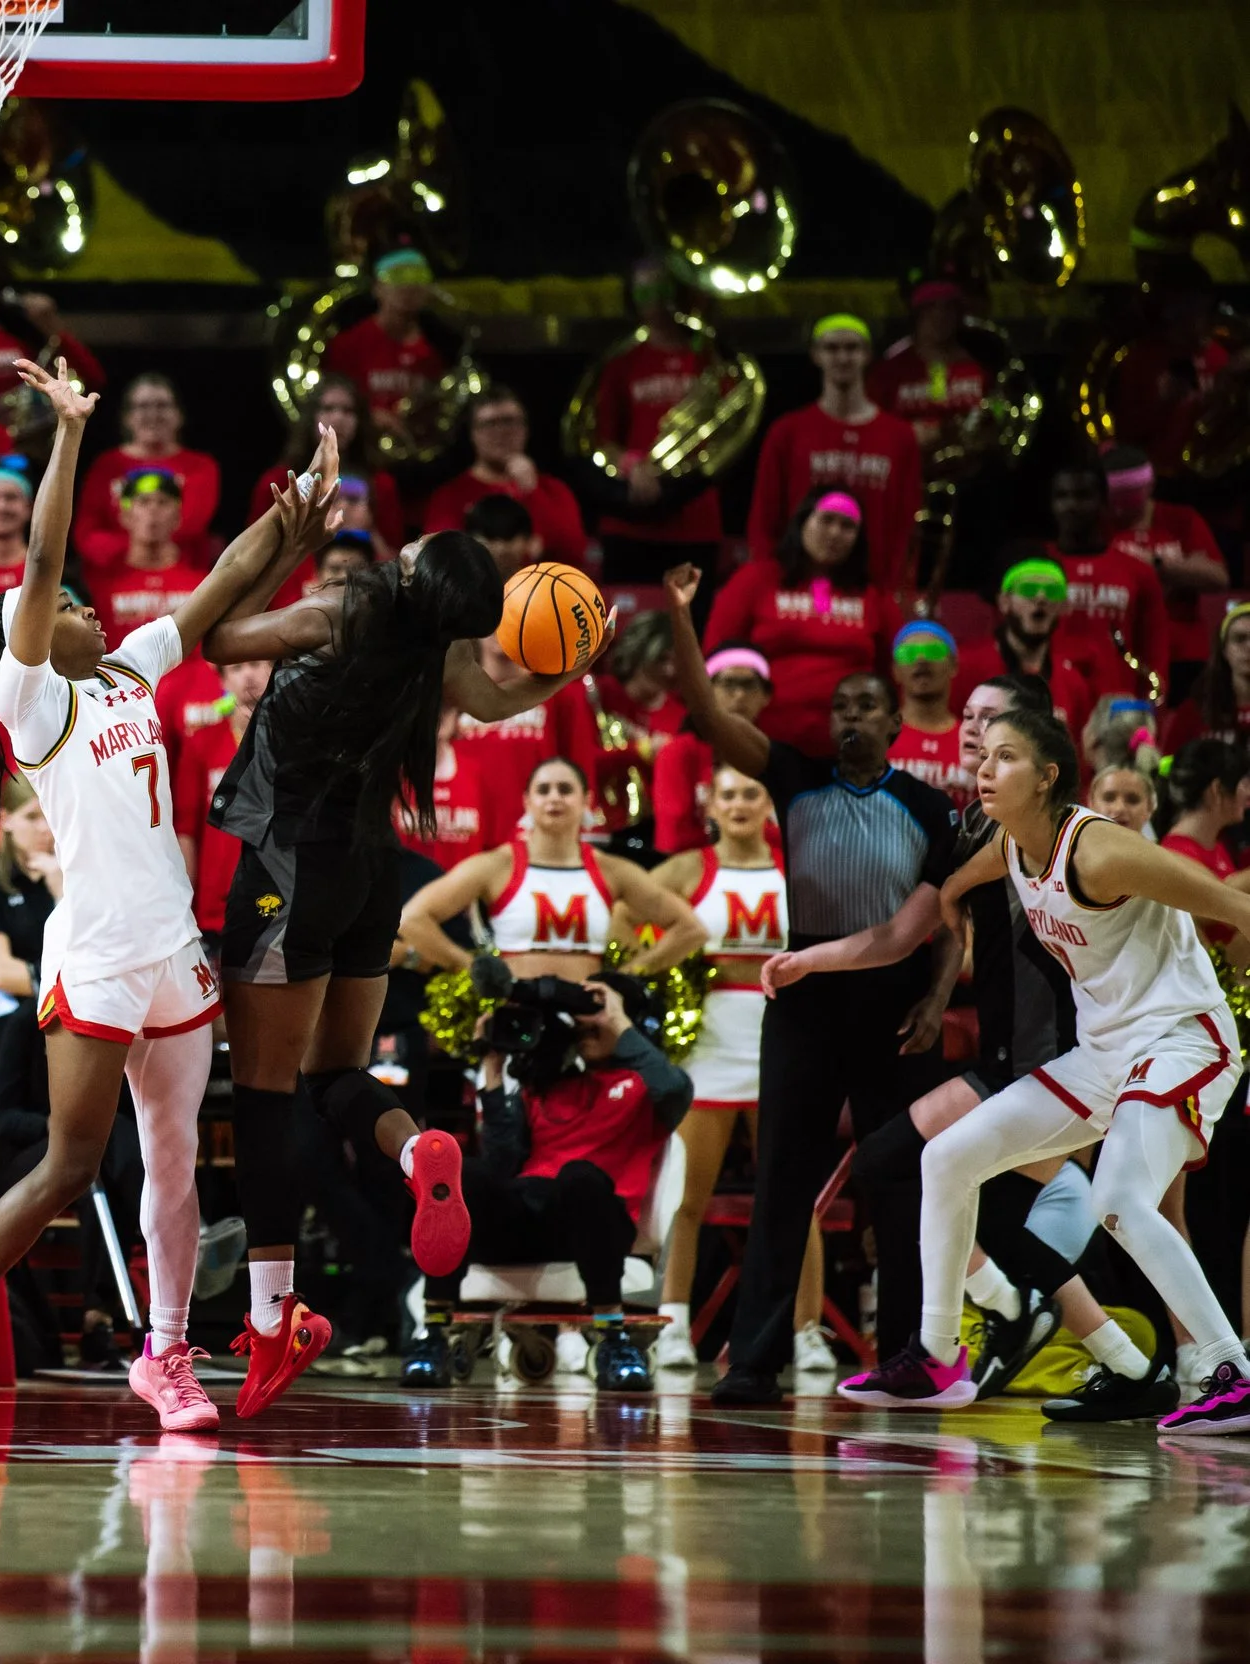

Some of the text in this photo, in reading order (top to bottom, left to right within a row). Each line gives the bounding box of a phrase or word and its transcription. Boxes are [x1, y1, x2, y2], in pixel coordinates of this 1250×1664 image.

[89, 719, 164, 767] MARYLA
[132, 752, 160, 828] 7
[531, 890, 589, 943] M
[723, 890, 784, 940] M
[1027, 908, 1088, 946] RYLAND
[1125, 1058, 1156, 1085] M
